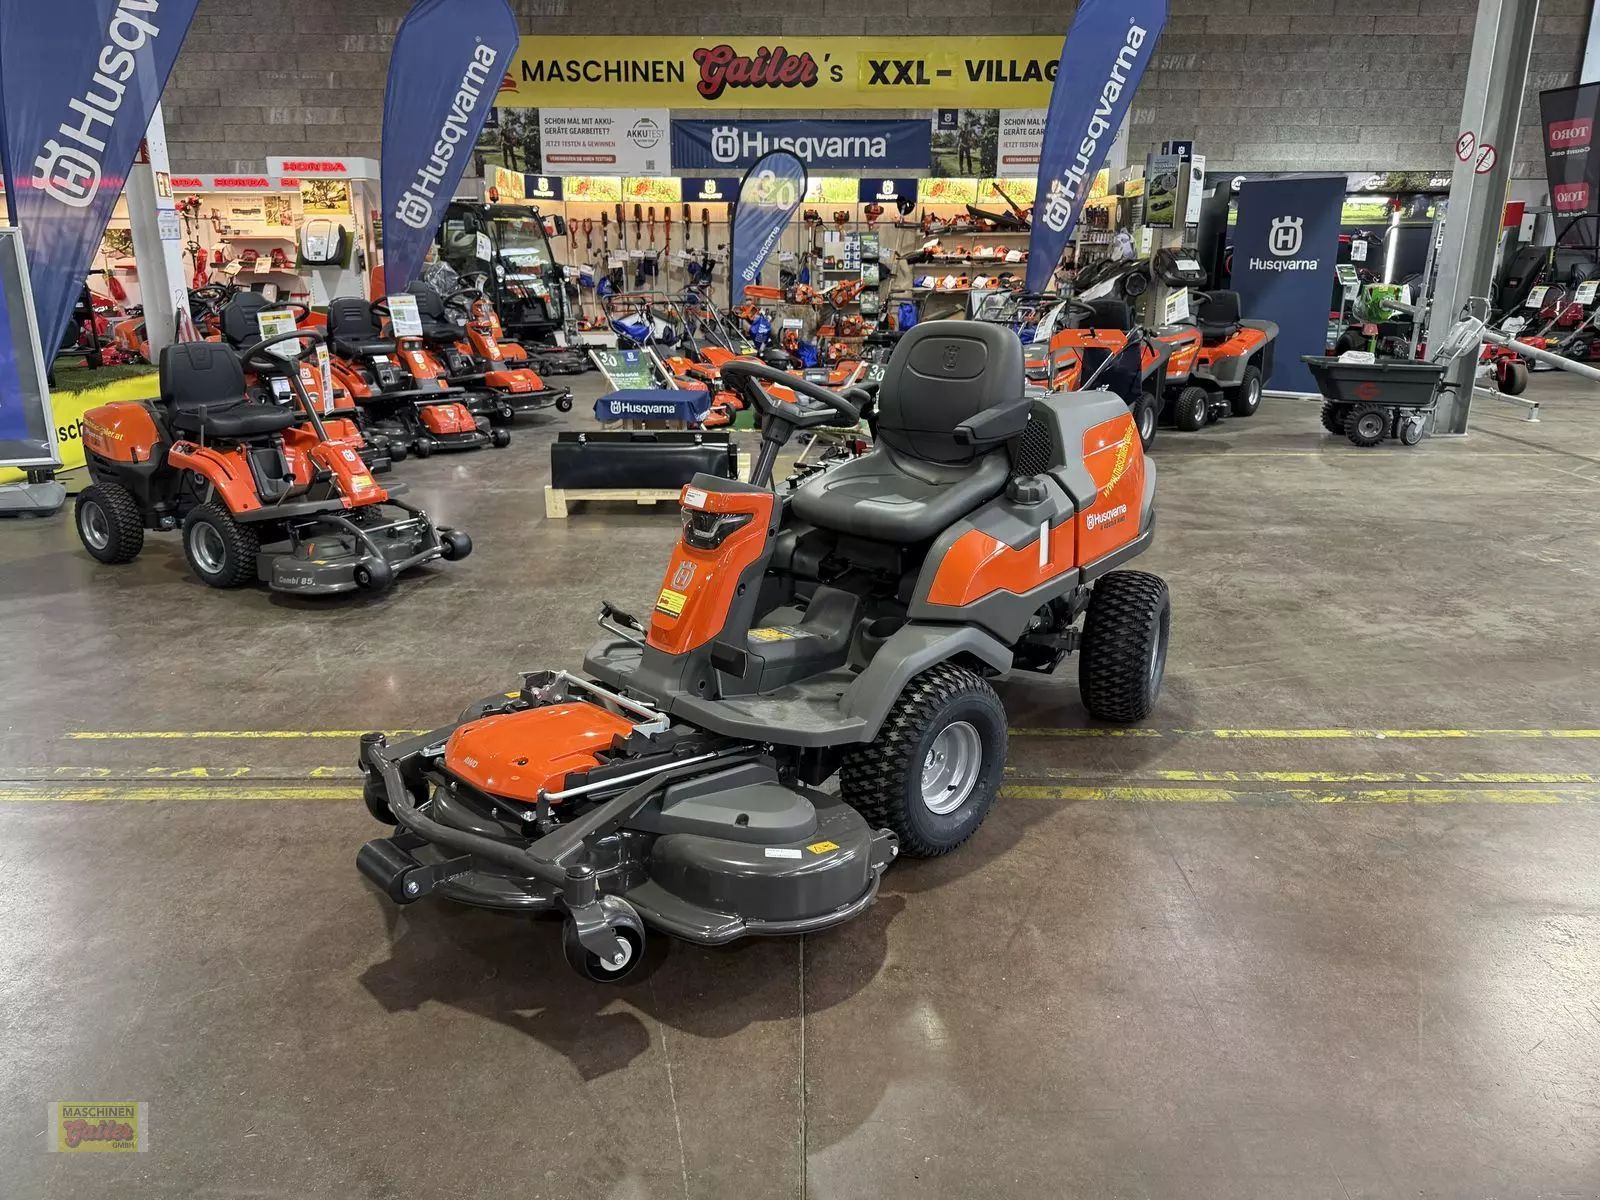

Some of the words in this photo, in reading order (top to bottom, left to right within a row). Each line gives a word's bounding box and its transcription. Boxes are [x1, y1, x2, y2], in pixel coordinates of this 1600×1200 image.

[59, 0, 161, 152] Husqv
[521, 59, 685, 82] MASCHINEN
[692, 44, 819, 100] Gailer
[965, 59, 1060, 82] VILLAG
[411, 44, 497, 198] Husqvarna
[1059, 24, 1147, 199] Husqvarna
[743, 131, 886, 162] Husqvarna
[213, 178, 270, 187] HONDA
[282, 162, 347, 172] HONDA
[749, 226, 781, 273] Husqvarna
[1249, 257, 1318, 272] Husqvarna
[622, 403, 675, 414] Husqvarna
[1095, 504, 1126, 523] Husqvarna
